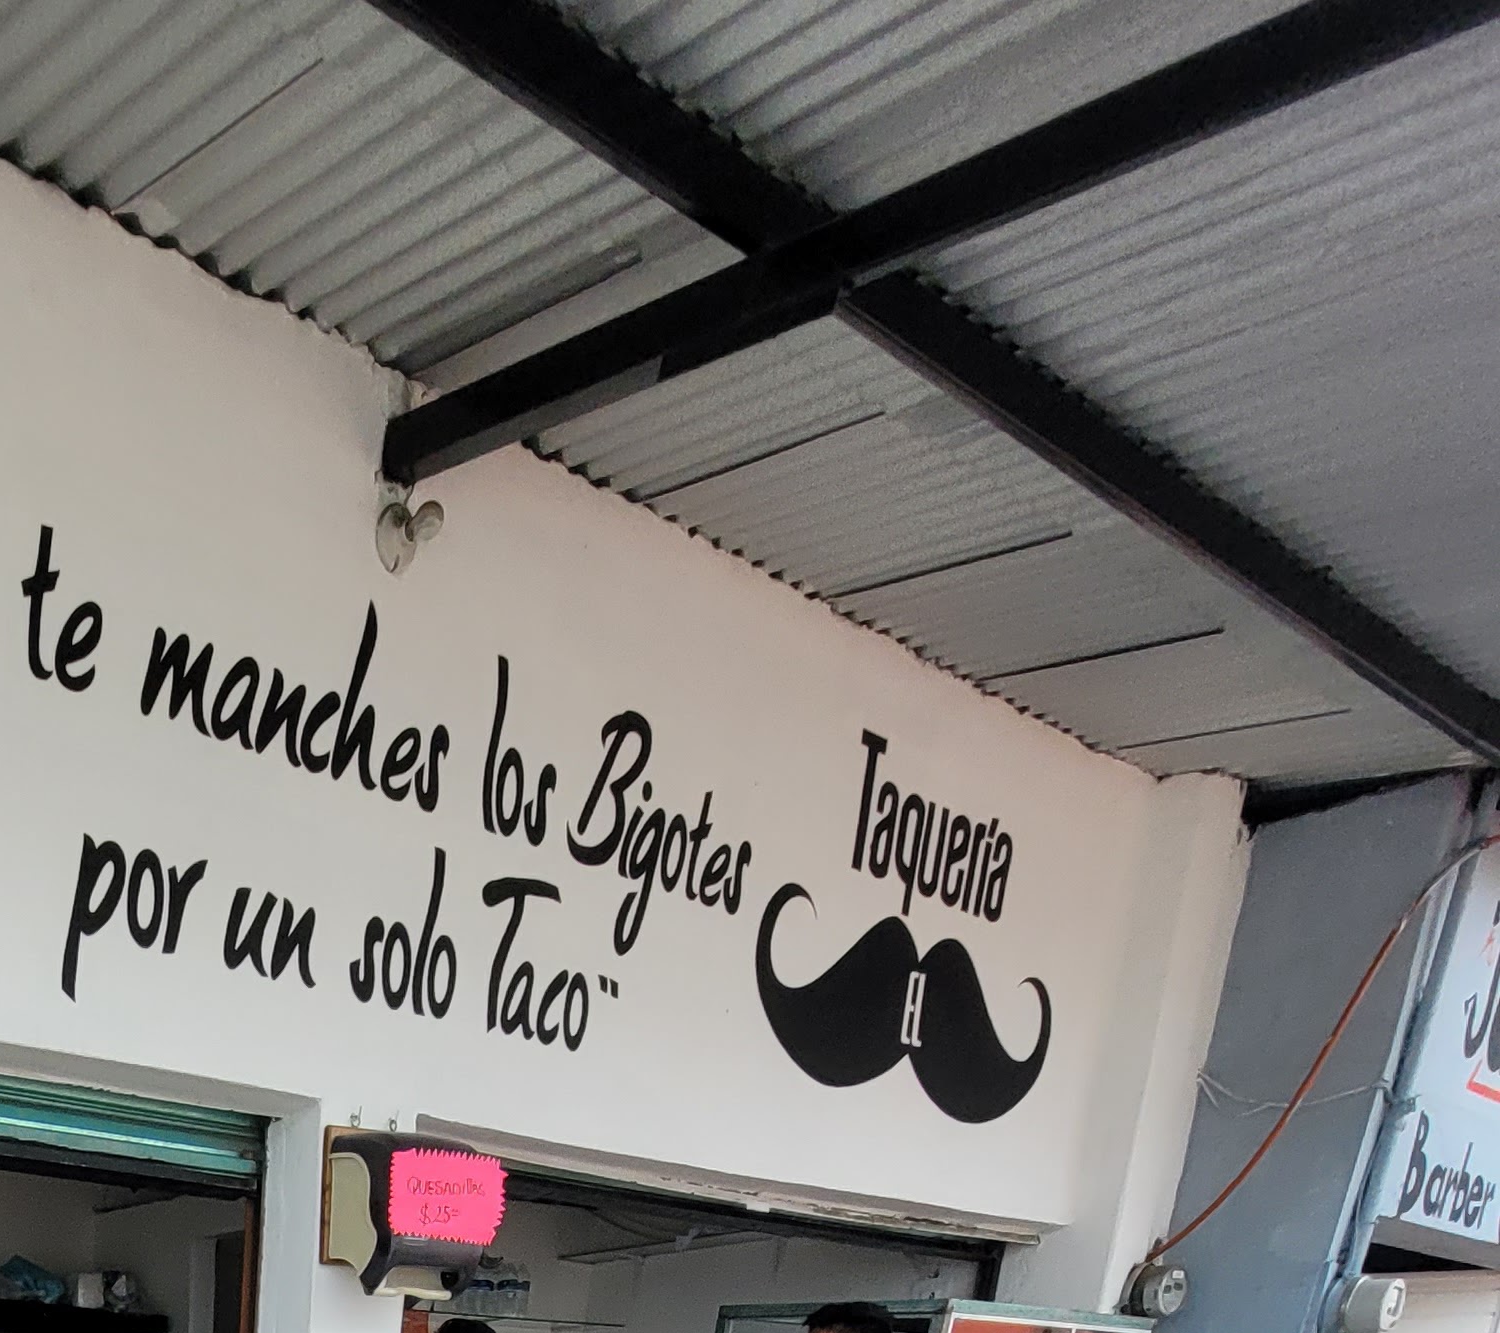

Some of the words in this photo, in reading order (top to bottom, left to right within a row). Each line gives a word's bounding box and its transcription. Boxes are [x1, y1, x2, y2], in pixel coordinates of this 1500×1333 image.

[21, 525, 102, 692] te
[140, 600, 450, 813] manches
[482, 655, 557, 847] los
[566, 710, 752, 956] Bigotes
[851, 728, 1013, 923] Taquería
[61, 833, 208, 1001] por
[223, 887, 316, 988] un
[349, 847, 457, 1019] solo
[900, 970, 927, 1048] El
[1397, 1109, 1496, 1230] Barber
